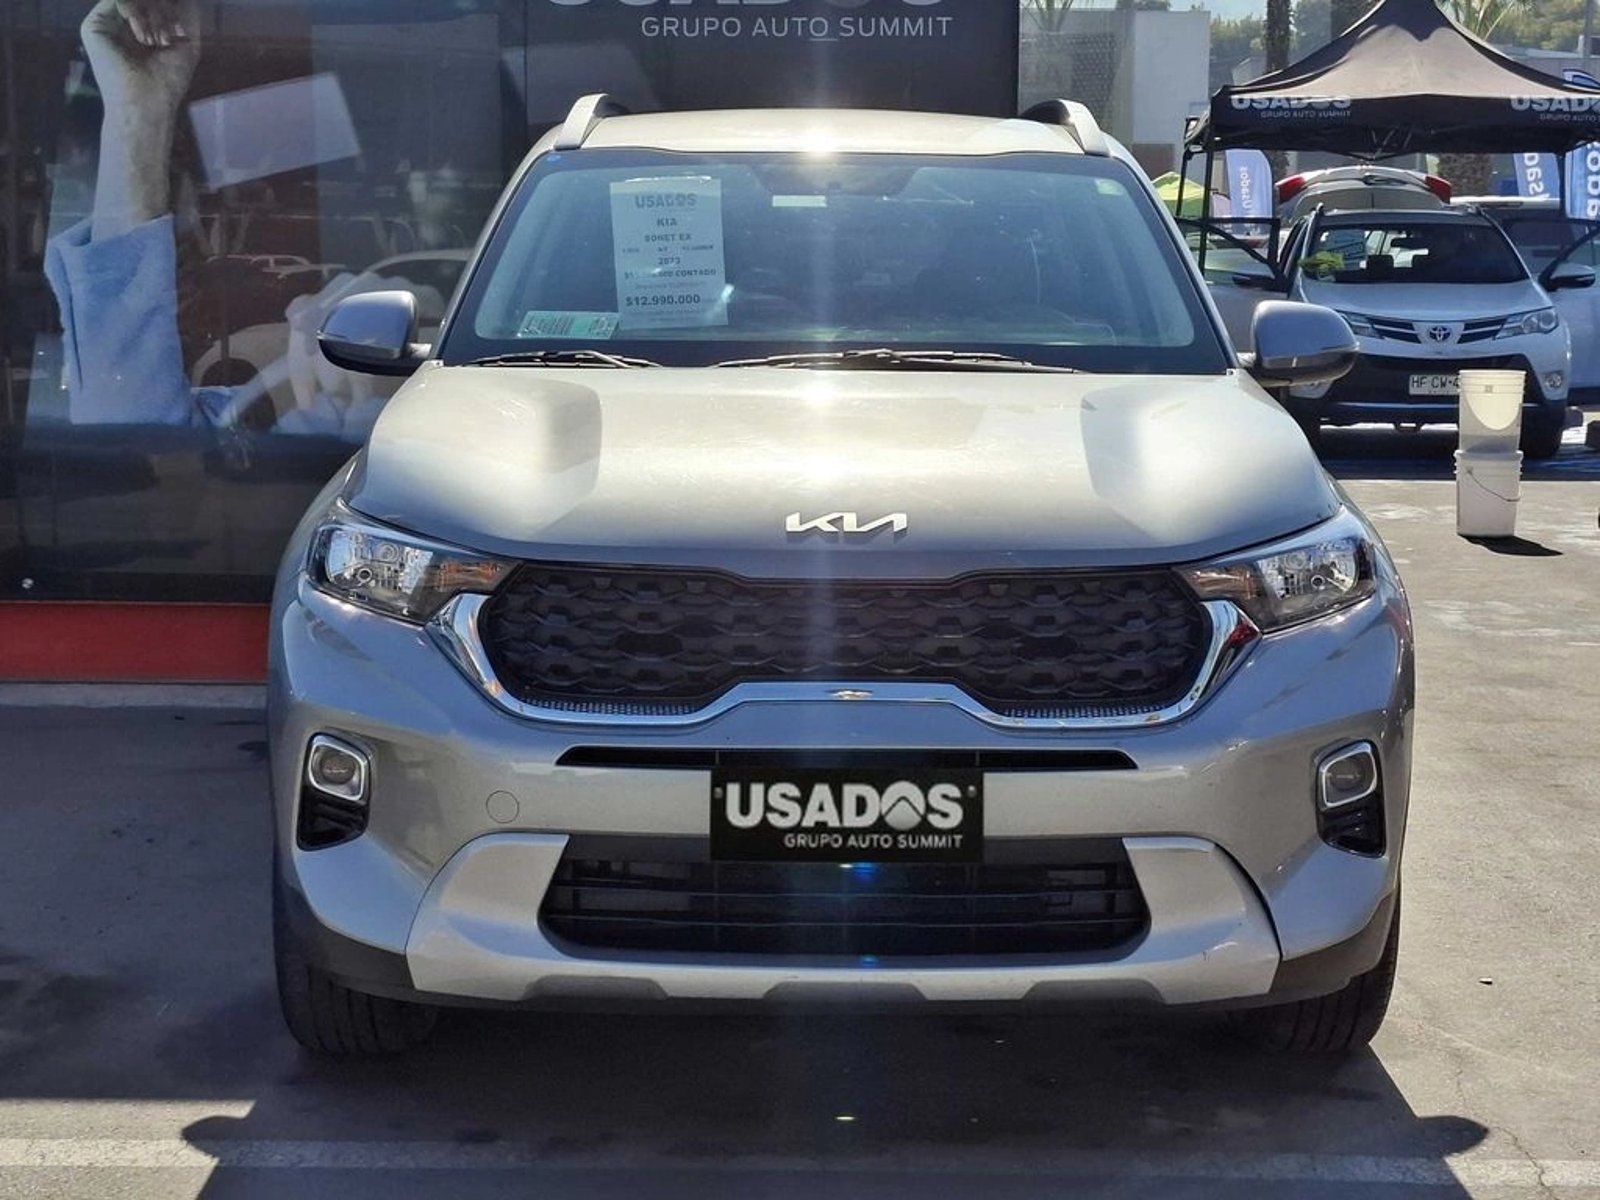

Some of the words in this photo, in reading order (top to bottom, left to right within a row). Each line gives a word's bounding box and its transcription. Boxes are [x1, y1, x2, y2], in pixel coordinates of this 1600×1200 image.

[641, 16, 741, 38] GRUPO
[751, 16, 829, 38] AUTO
[838, 16, 953, 38] SUMMIT
[634, 192, 697, 209] USADOS
[657, 217, 678, 228] KIA
[625, 293, 701, 308] $12.990.000
[785, 511, 908, 533] KIA
[725, 780, 964, 831] USADOS
[783, 833, 843, 849] GRUPO
[847, 834, 893, 849] AUTO
[897, 834, 964, 849] SUMMIT
